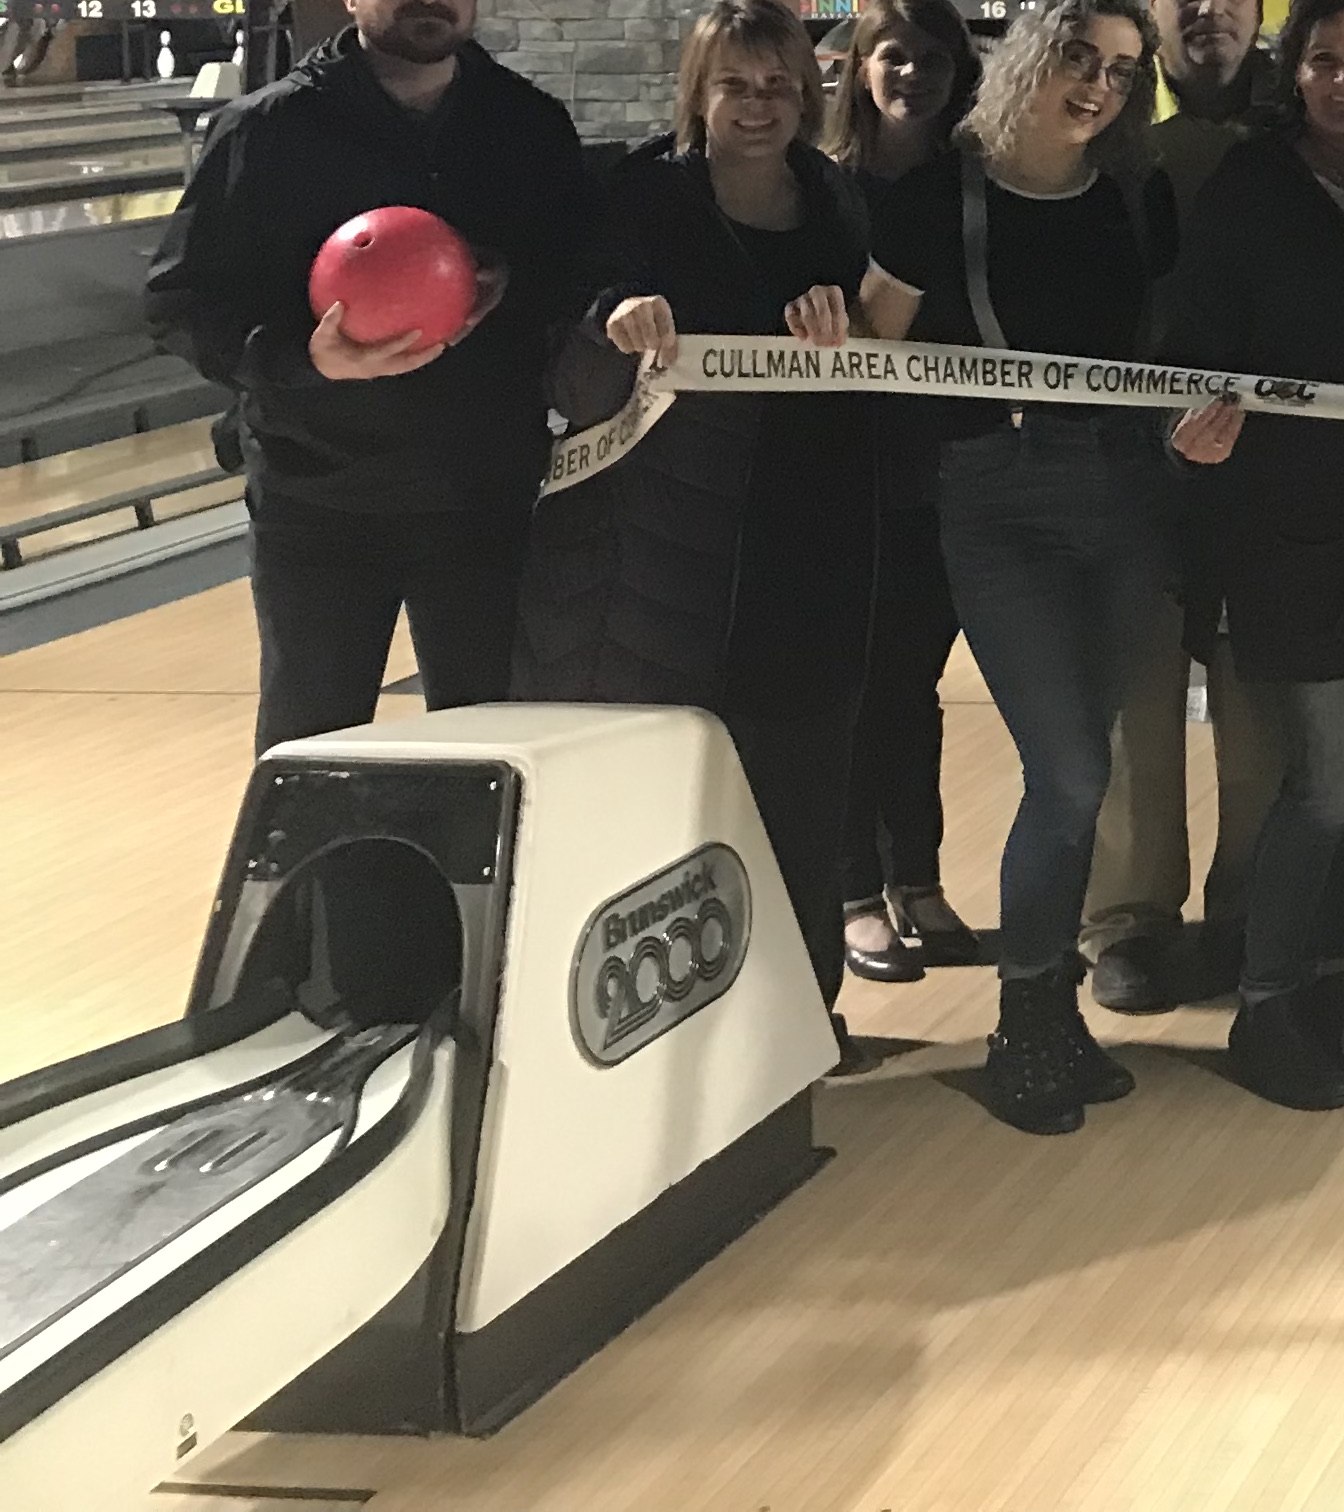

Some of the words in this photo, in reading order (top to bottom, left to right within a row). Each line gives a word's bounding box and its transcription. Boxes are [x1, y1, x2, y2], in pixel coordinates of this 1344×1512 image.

[77, 0, 103, 18] 12
[131, 0, 157, 18] 13
[980, 1, 1007, 19] 16
[702, 347, 821, 379] CULLMAN
[830, 351, 900, 381] AREA
[905, 354, 1034, 390] CHAMBER
[1043, 361, 1079, 390] OF
[1086, 363, 1241, 396] COMMERCE
